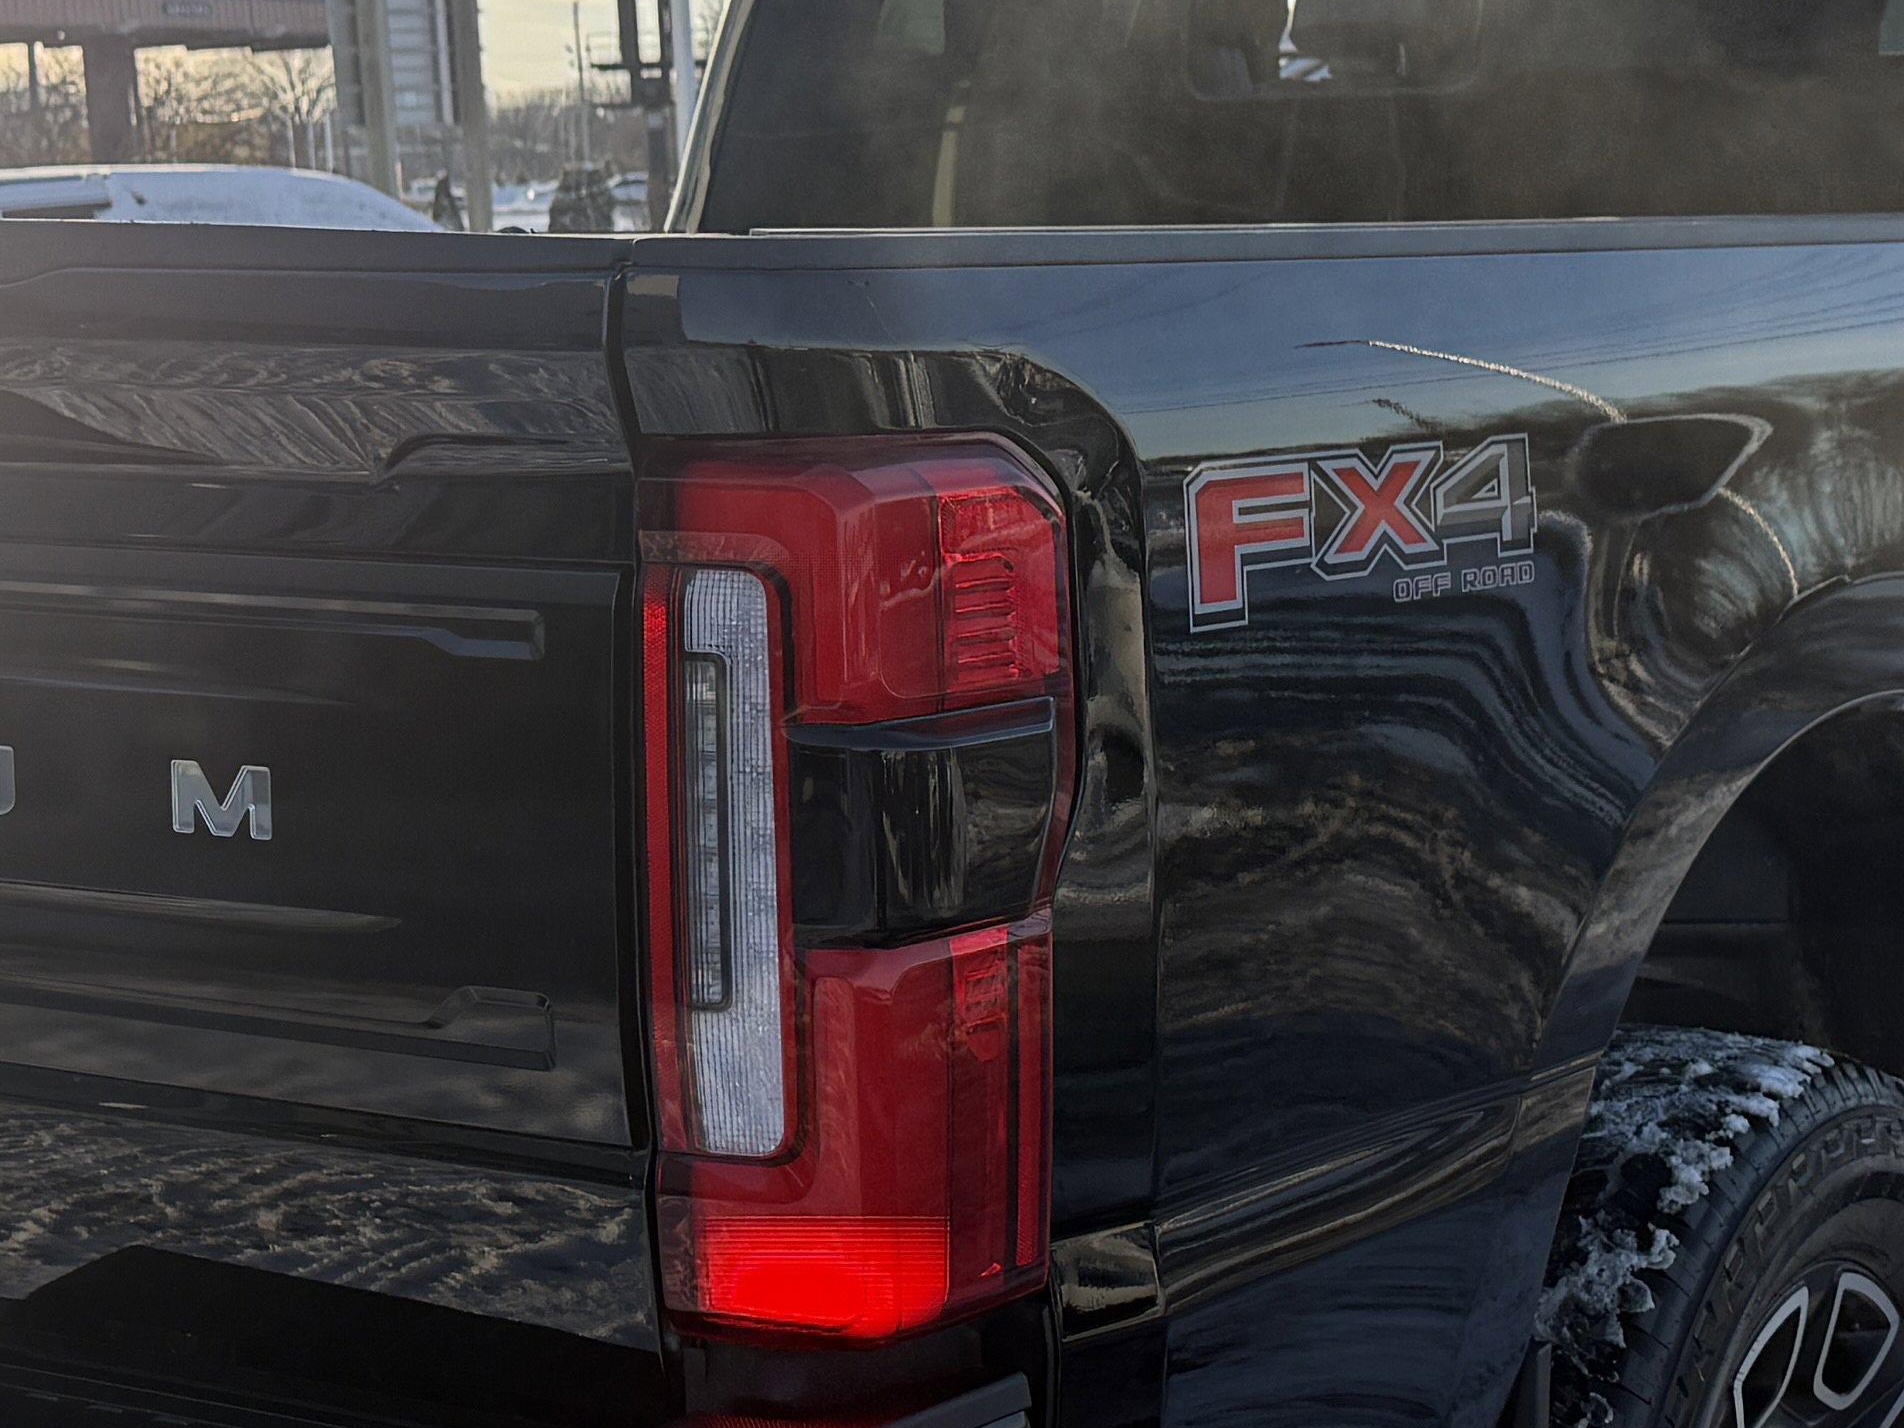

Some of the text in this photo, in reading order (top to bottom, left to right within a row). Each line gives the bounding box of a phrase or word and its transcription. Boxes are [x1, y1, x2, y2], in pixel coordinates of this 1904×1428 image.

[1183, 432, 1537, 634] FX4
[1392, 560, 1535, 604] OFF ROAD
